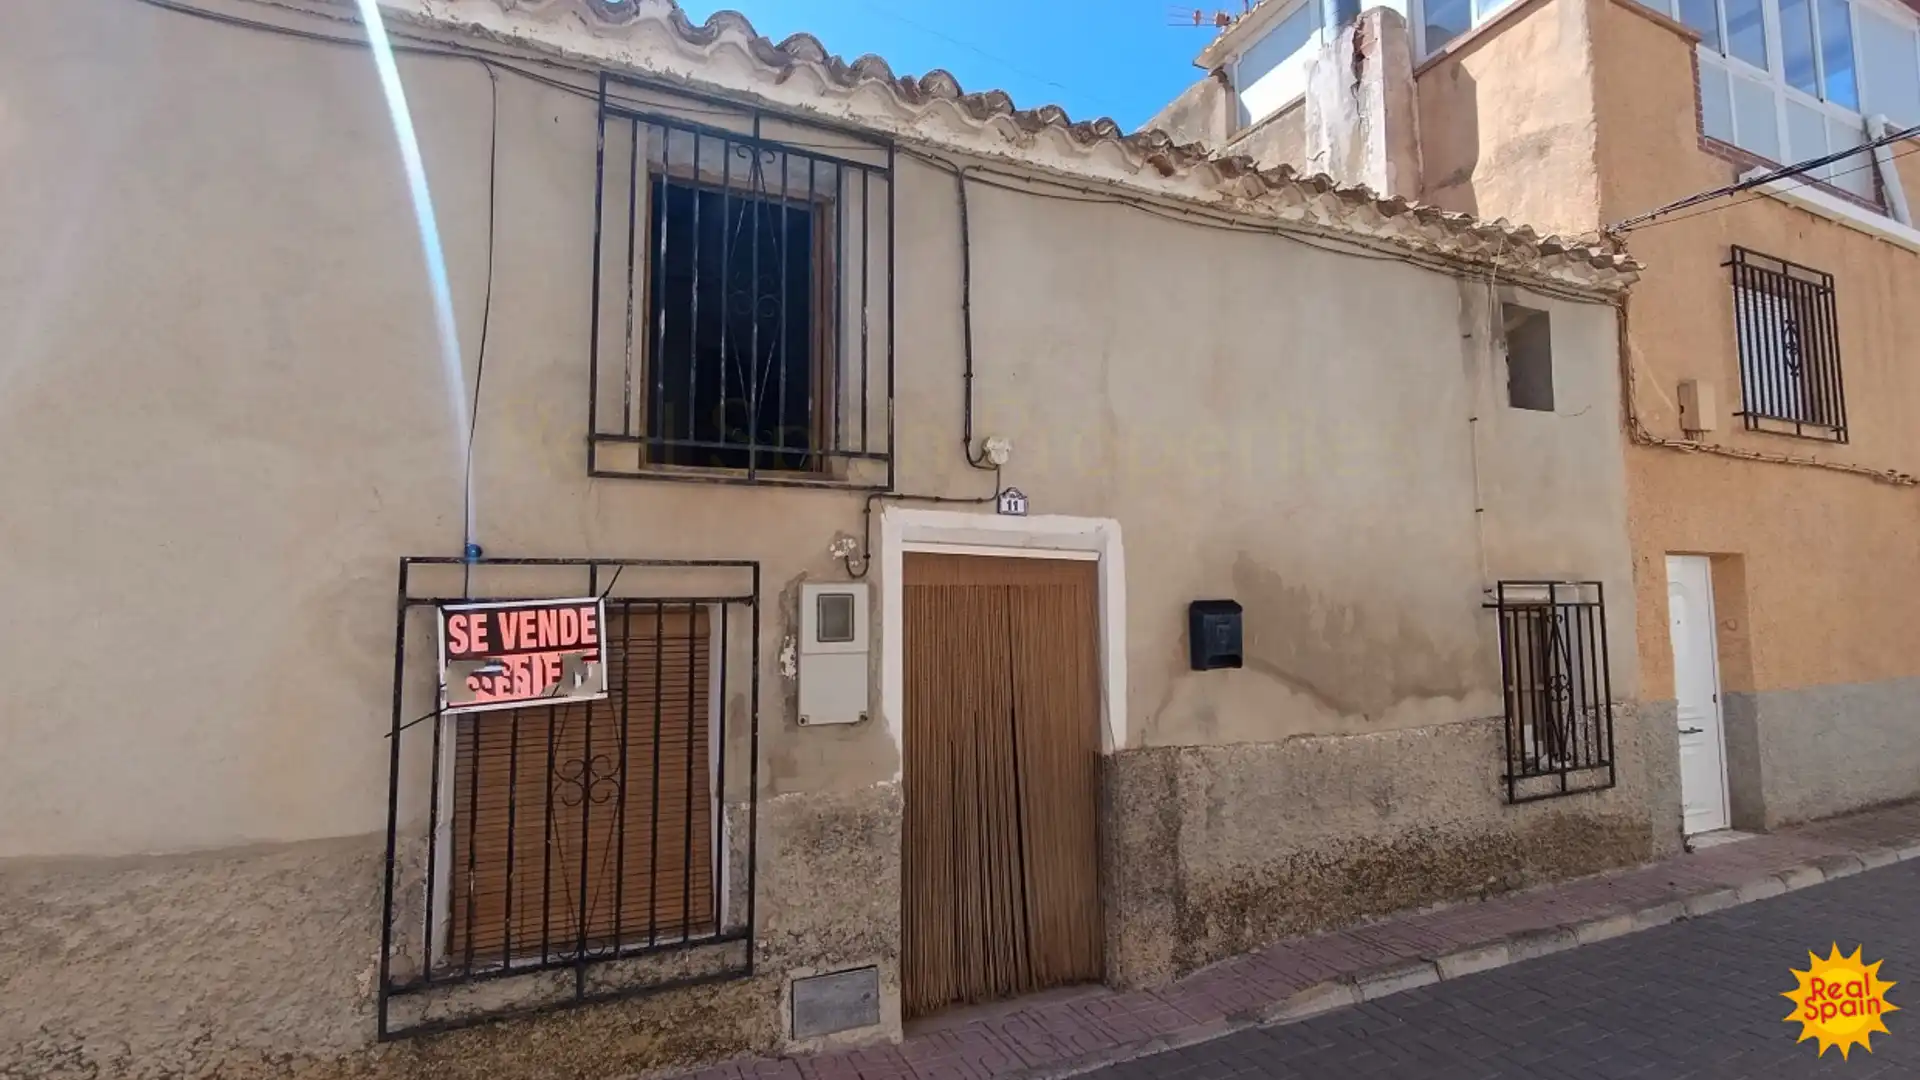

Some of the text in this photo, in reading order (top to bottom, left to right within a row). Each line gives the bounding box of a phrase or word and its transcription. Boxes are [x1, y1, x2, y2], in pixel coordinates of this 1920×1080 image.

[1007, 500, 1018, 511] 11
[448, 606, 597, 654] SE VENDE
